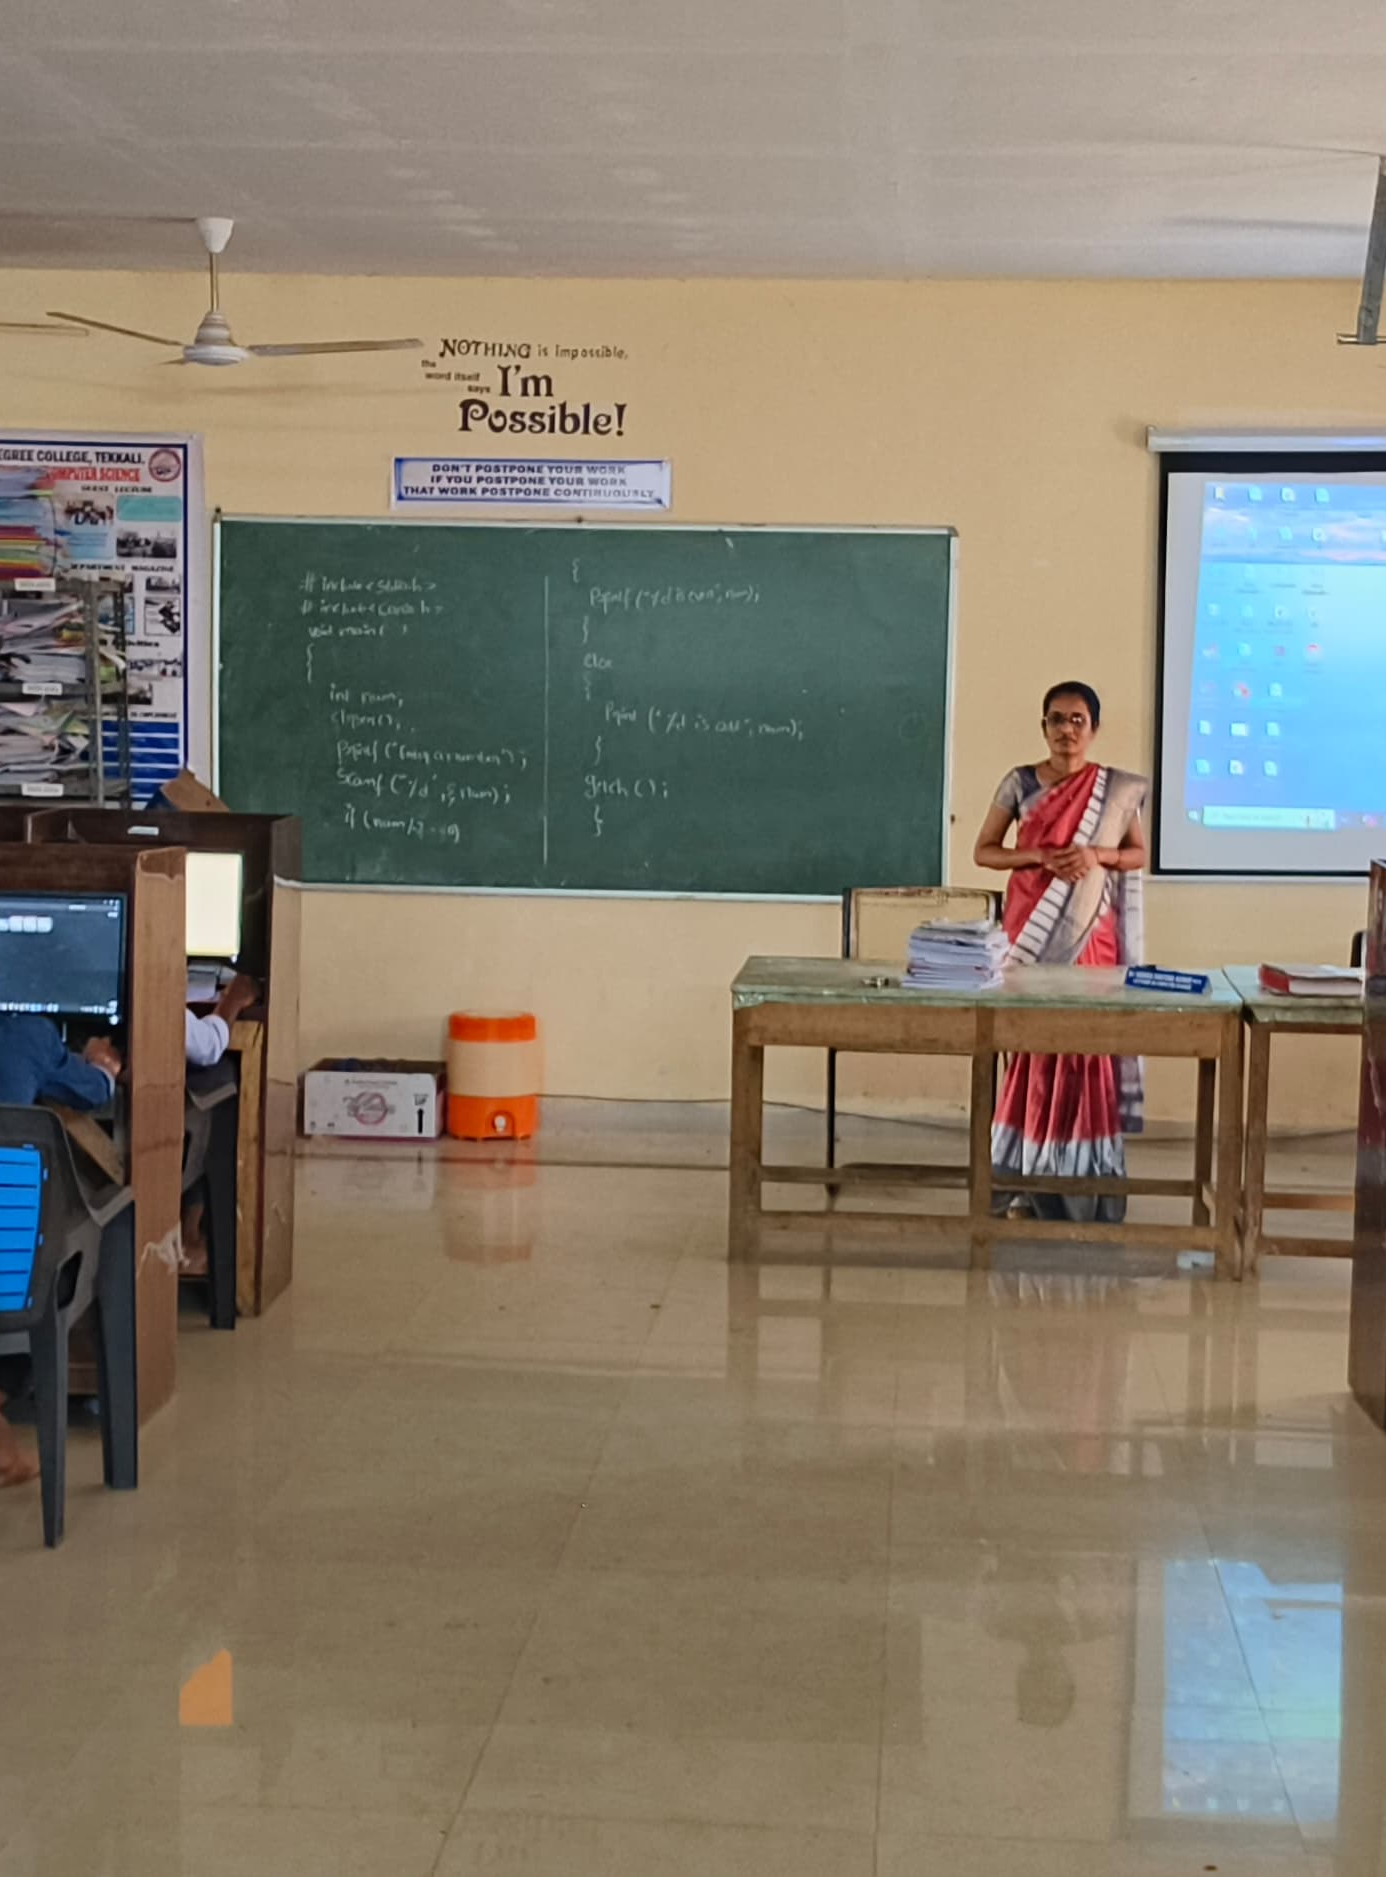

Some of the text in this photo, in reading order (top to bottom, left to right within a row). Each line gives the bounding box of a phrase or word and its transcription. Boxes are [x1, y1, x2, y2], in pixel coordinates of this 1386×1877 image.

[439, 338, 531, 359] NOTHING
[537, 344, 548, 357] is
[421, 359, 437, 368] the
[425, 370, 481, 382] word itself
[467, 364, 554, 398] says I'm
[458, 398, 627, 437] Possible!
[37, 451, 92, 465] COLLEGE,
[432, 464, 626, 475] DON'T POSTPONE YOUR WORK
[431, 475, 628, 486] IF YOU POSTPONE YOUR WORK
[404, 486, 434, 495] THAT
[438, 486, 478, 495] WORK
[481, 487, 550, 497] POSTPONE
